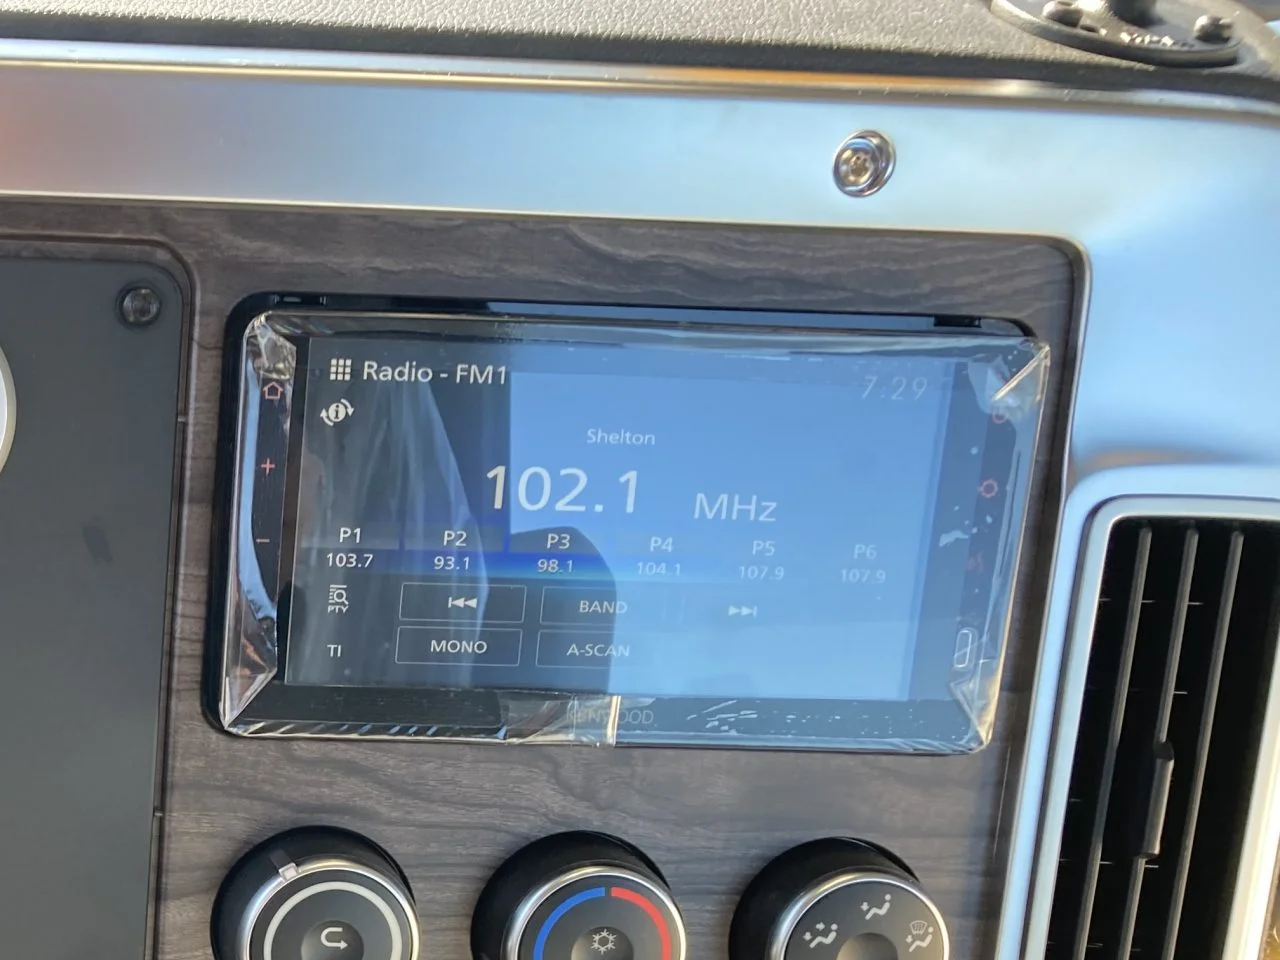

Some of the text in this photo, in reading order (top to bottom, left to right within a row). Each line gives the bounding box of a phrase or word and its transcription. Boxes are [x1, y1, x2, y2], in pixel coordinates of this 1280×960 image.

[363, 360, 433, 383] Radio
[455, 363, 508, 385] FM1
[861, 376, 928, 401] 7:29
[586, 428, 656, 445] Shelton
[486, 465, 778, 522] 102.1 MHz
[339, 527, 361, 544] P1
[443, 530, 467, 547] P2
[547, 533, 570, 549] P3
[650, 536, 674, 553] P4
[752, 540, 776, 556] P5
[853, 543, 877, 560] P6
[326, 553, 374, 569] 103.7
[434, 556, 470, 571] 93.1
[537, 559, 574, 573] 98.1
[636, 562, 681, 577] 104.1
[738, 565, 785, 581] 107.9
[840, 569, 886, 584] 107.9
[327, 605, 349, 614] PTY
[579, 600, 628, 614] BAND
[327, 644, 342, 657] TI
[430, 640, 487, 654] MONO
[566, 643, 630, 657] A-SCAN
